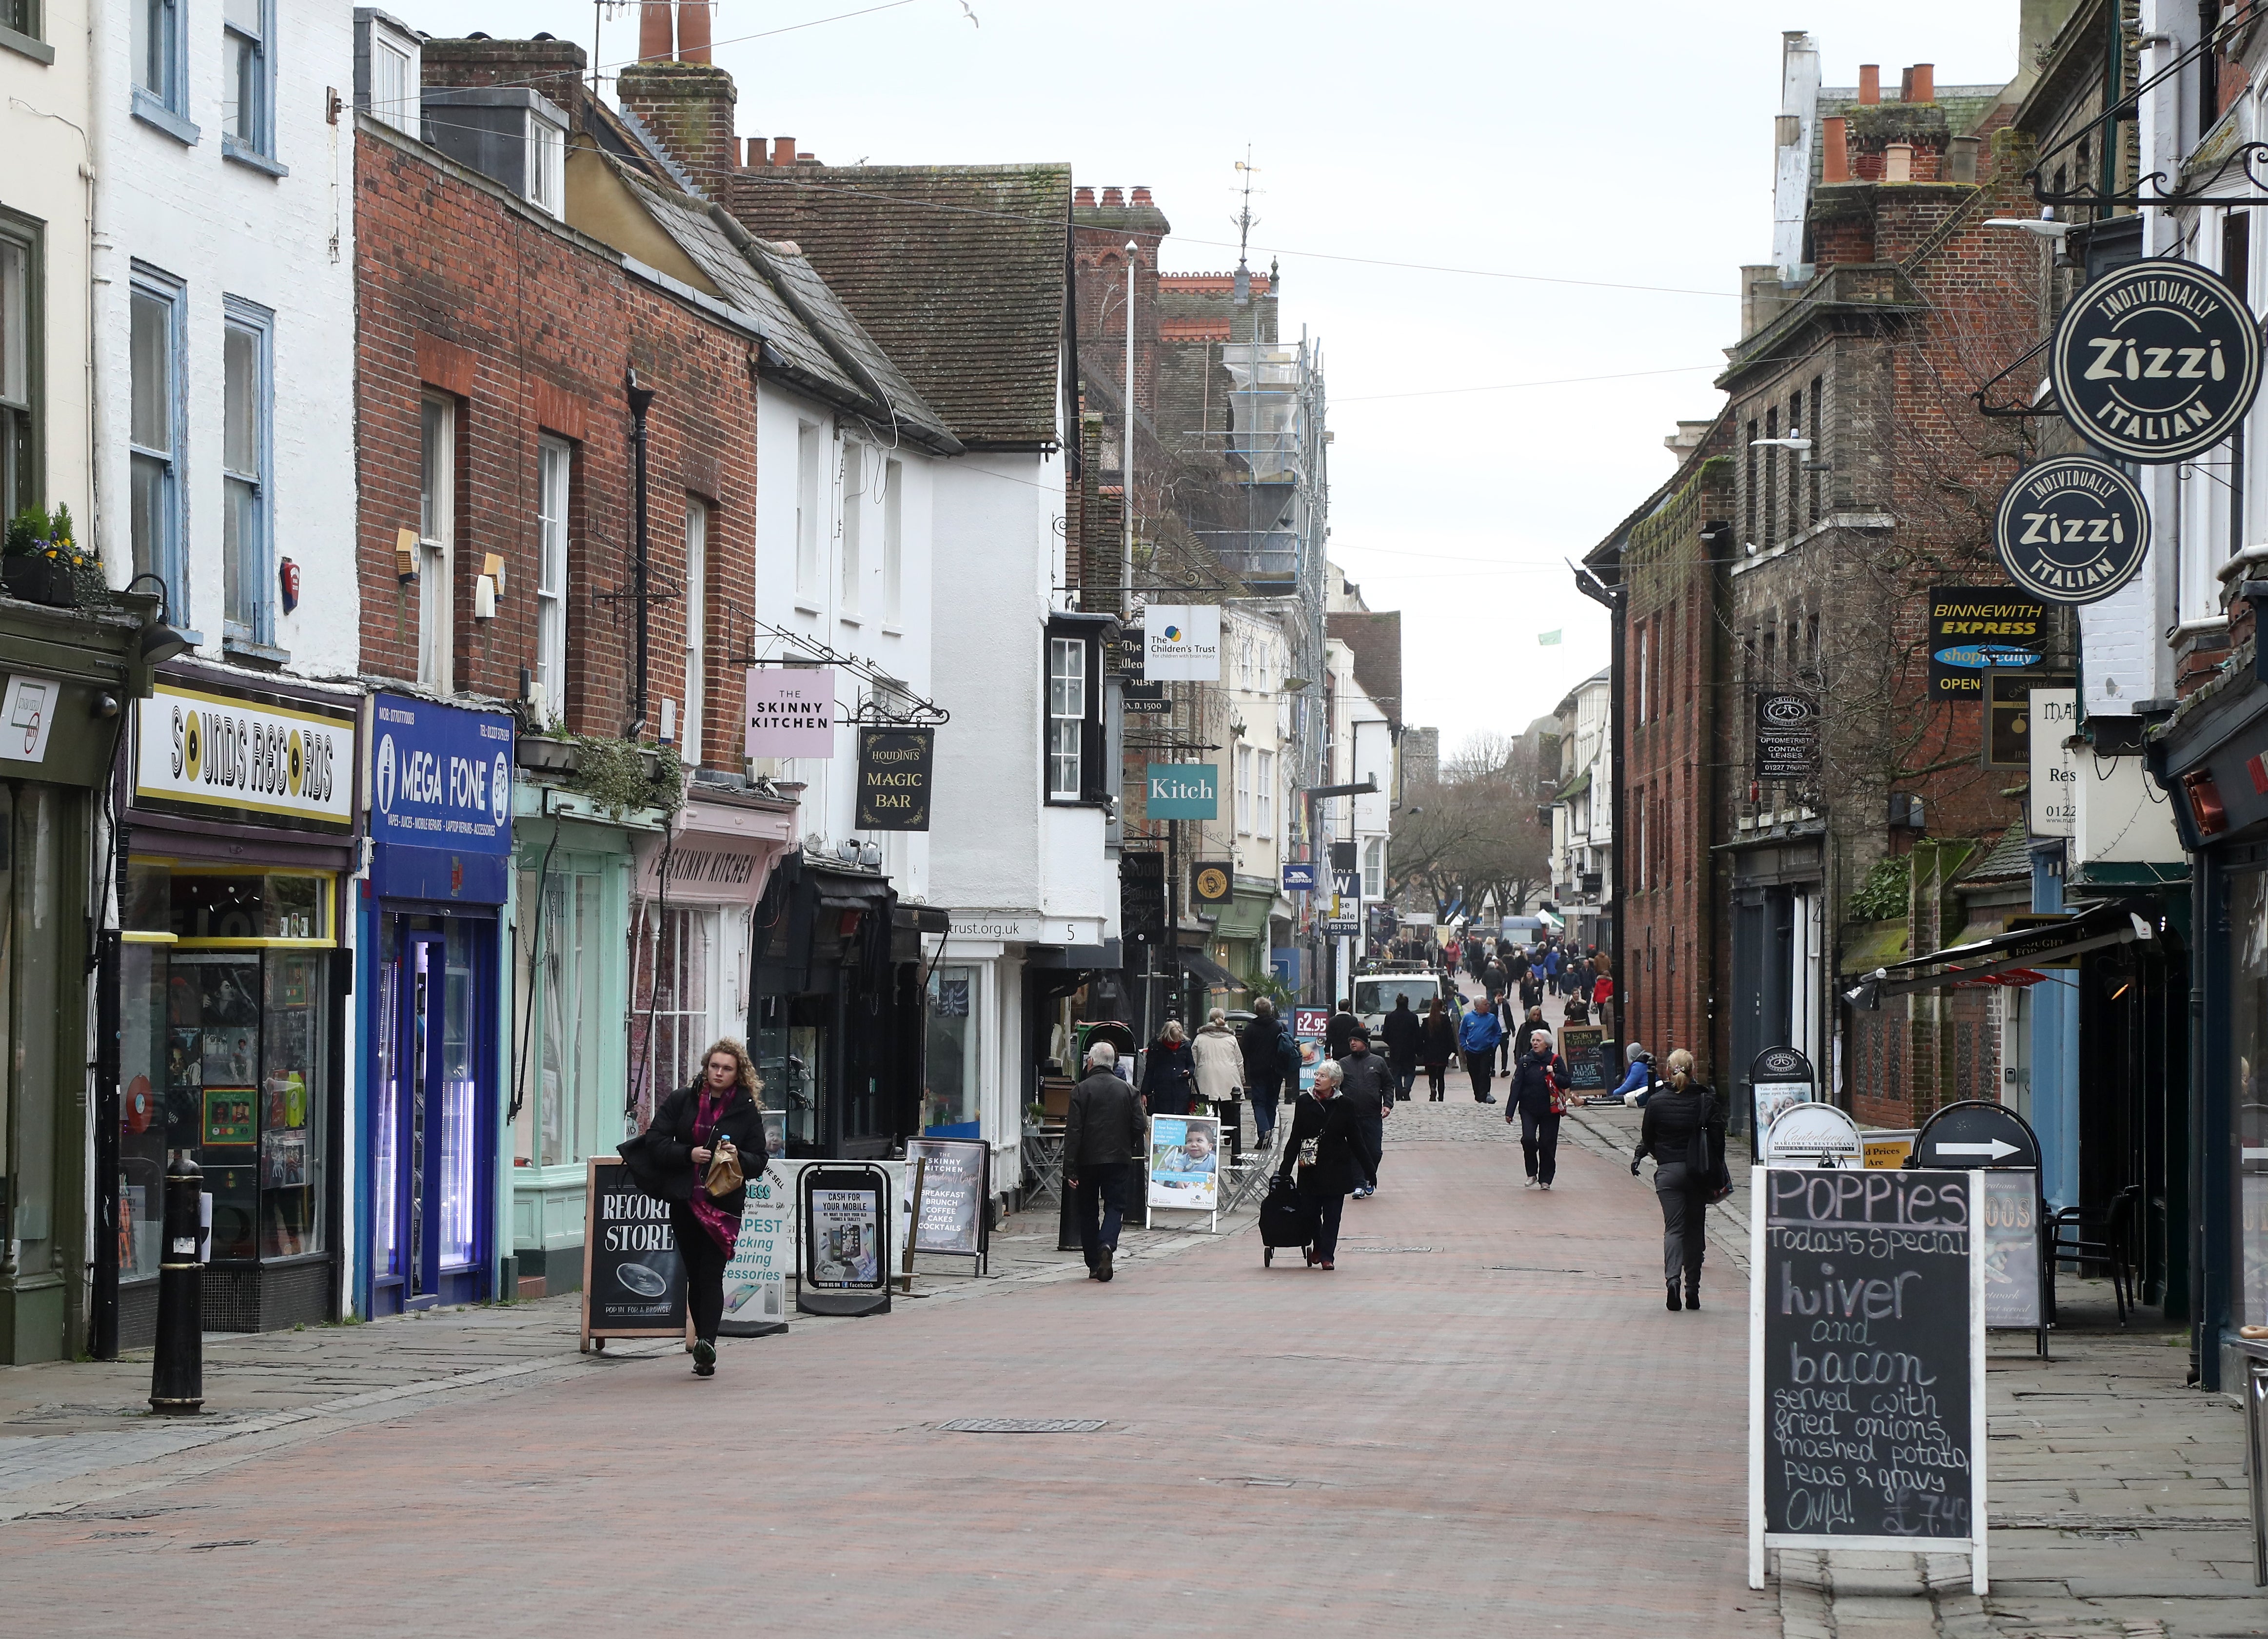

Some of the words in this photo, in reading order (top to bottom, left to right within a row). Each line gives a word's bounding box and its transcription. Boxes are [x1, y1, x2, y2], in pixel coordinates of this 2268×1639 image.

[2096, 280, 2219, 320] INDIVIDUALLY
[2083, 337, 2226, 381] Zizzi
[2096, 400, 2212, 440] ITALIAN
[2028, 470, 2118, 500] INDIVIDUALLY
[2019, 513, 2124, 545] Zizzi
[2029, 557, 2115, 587] ITALIAN
[1933, 605, 2043, 618] BINNEWITH
[1941, 621, 2036, 634] EXPRESS
[1121, 640, 1142, 653] The
[1940, 678, 1980, 690] OPEN
[379, 707, 390, 722] MOB:
[757, 702, 823, 713] SKINNY
[1144, 702, 1162, 711] 1500
[487, 726, 497, 739] 01227
[751, 718, 828, 728] KITCHEN
[251, 722, 333, 802] RECORDS
[872, 748, 921, 764] HOUDINI'S
[401, 748, 442, 804] MEGA
[449, 756, 487, 811] FONE
[867, 772, 923, 787] MAGIC
[1150, 779, 1214, 799] Kitch
[875, 794, 911, 808] BAR
[388, 814, 399, 826] VAPES
[401, 818, 413, 829] JUICES
[414, 817, 428, 830] MOBILE
[428, 819, 442, 831] REPAIRS
[446, 820, 459, 832] LAPTOP
[670, 848, 712, 881] SKINNY
[708, 853, 757, 884] KITCHEN
[1066, 924, 1075, 940] 5
[1297, 1012, 1327, 1032] £2.95
[1783, 1126, 1845, 1143] Canterbury
[765, 1165, 772, 1176] WE
[771, 1173, 785, 1190] SELL
[921, 1190, 966, 1198] BREAKFAST
[926, 1198, 958, 1207] BRUNCH
[918, 1223, 961, 1231] COCKTAILS
[605, 1224, 674, 1252] STORE
[1767, 1227, 1865, 1255] Today's
[1811, 1316, 1877, 1346] and
[1790, 1341, 1937, 1385] bacon
[1774, 1384, 1858, 1412] served
[1871, 1385, 1942, 1419] with
[1774, 1408, 1841, 1441] fried
[1780, 1435, 1877, 1463] mashed
[1785, 1460, 1846, 1490] peas
[1856, 1466, 1874, 1488] &
[1878, 1468, 1946, 1502] gravy
